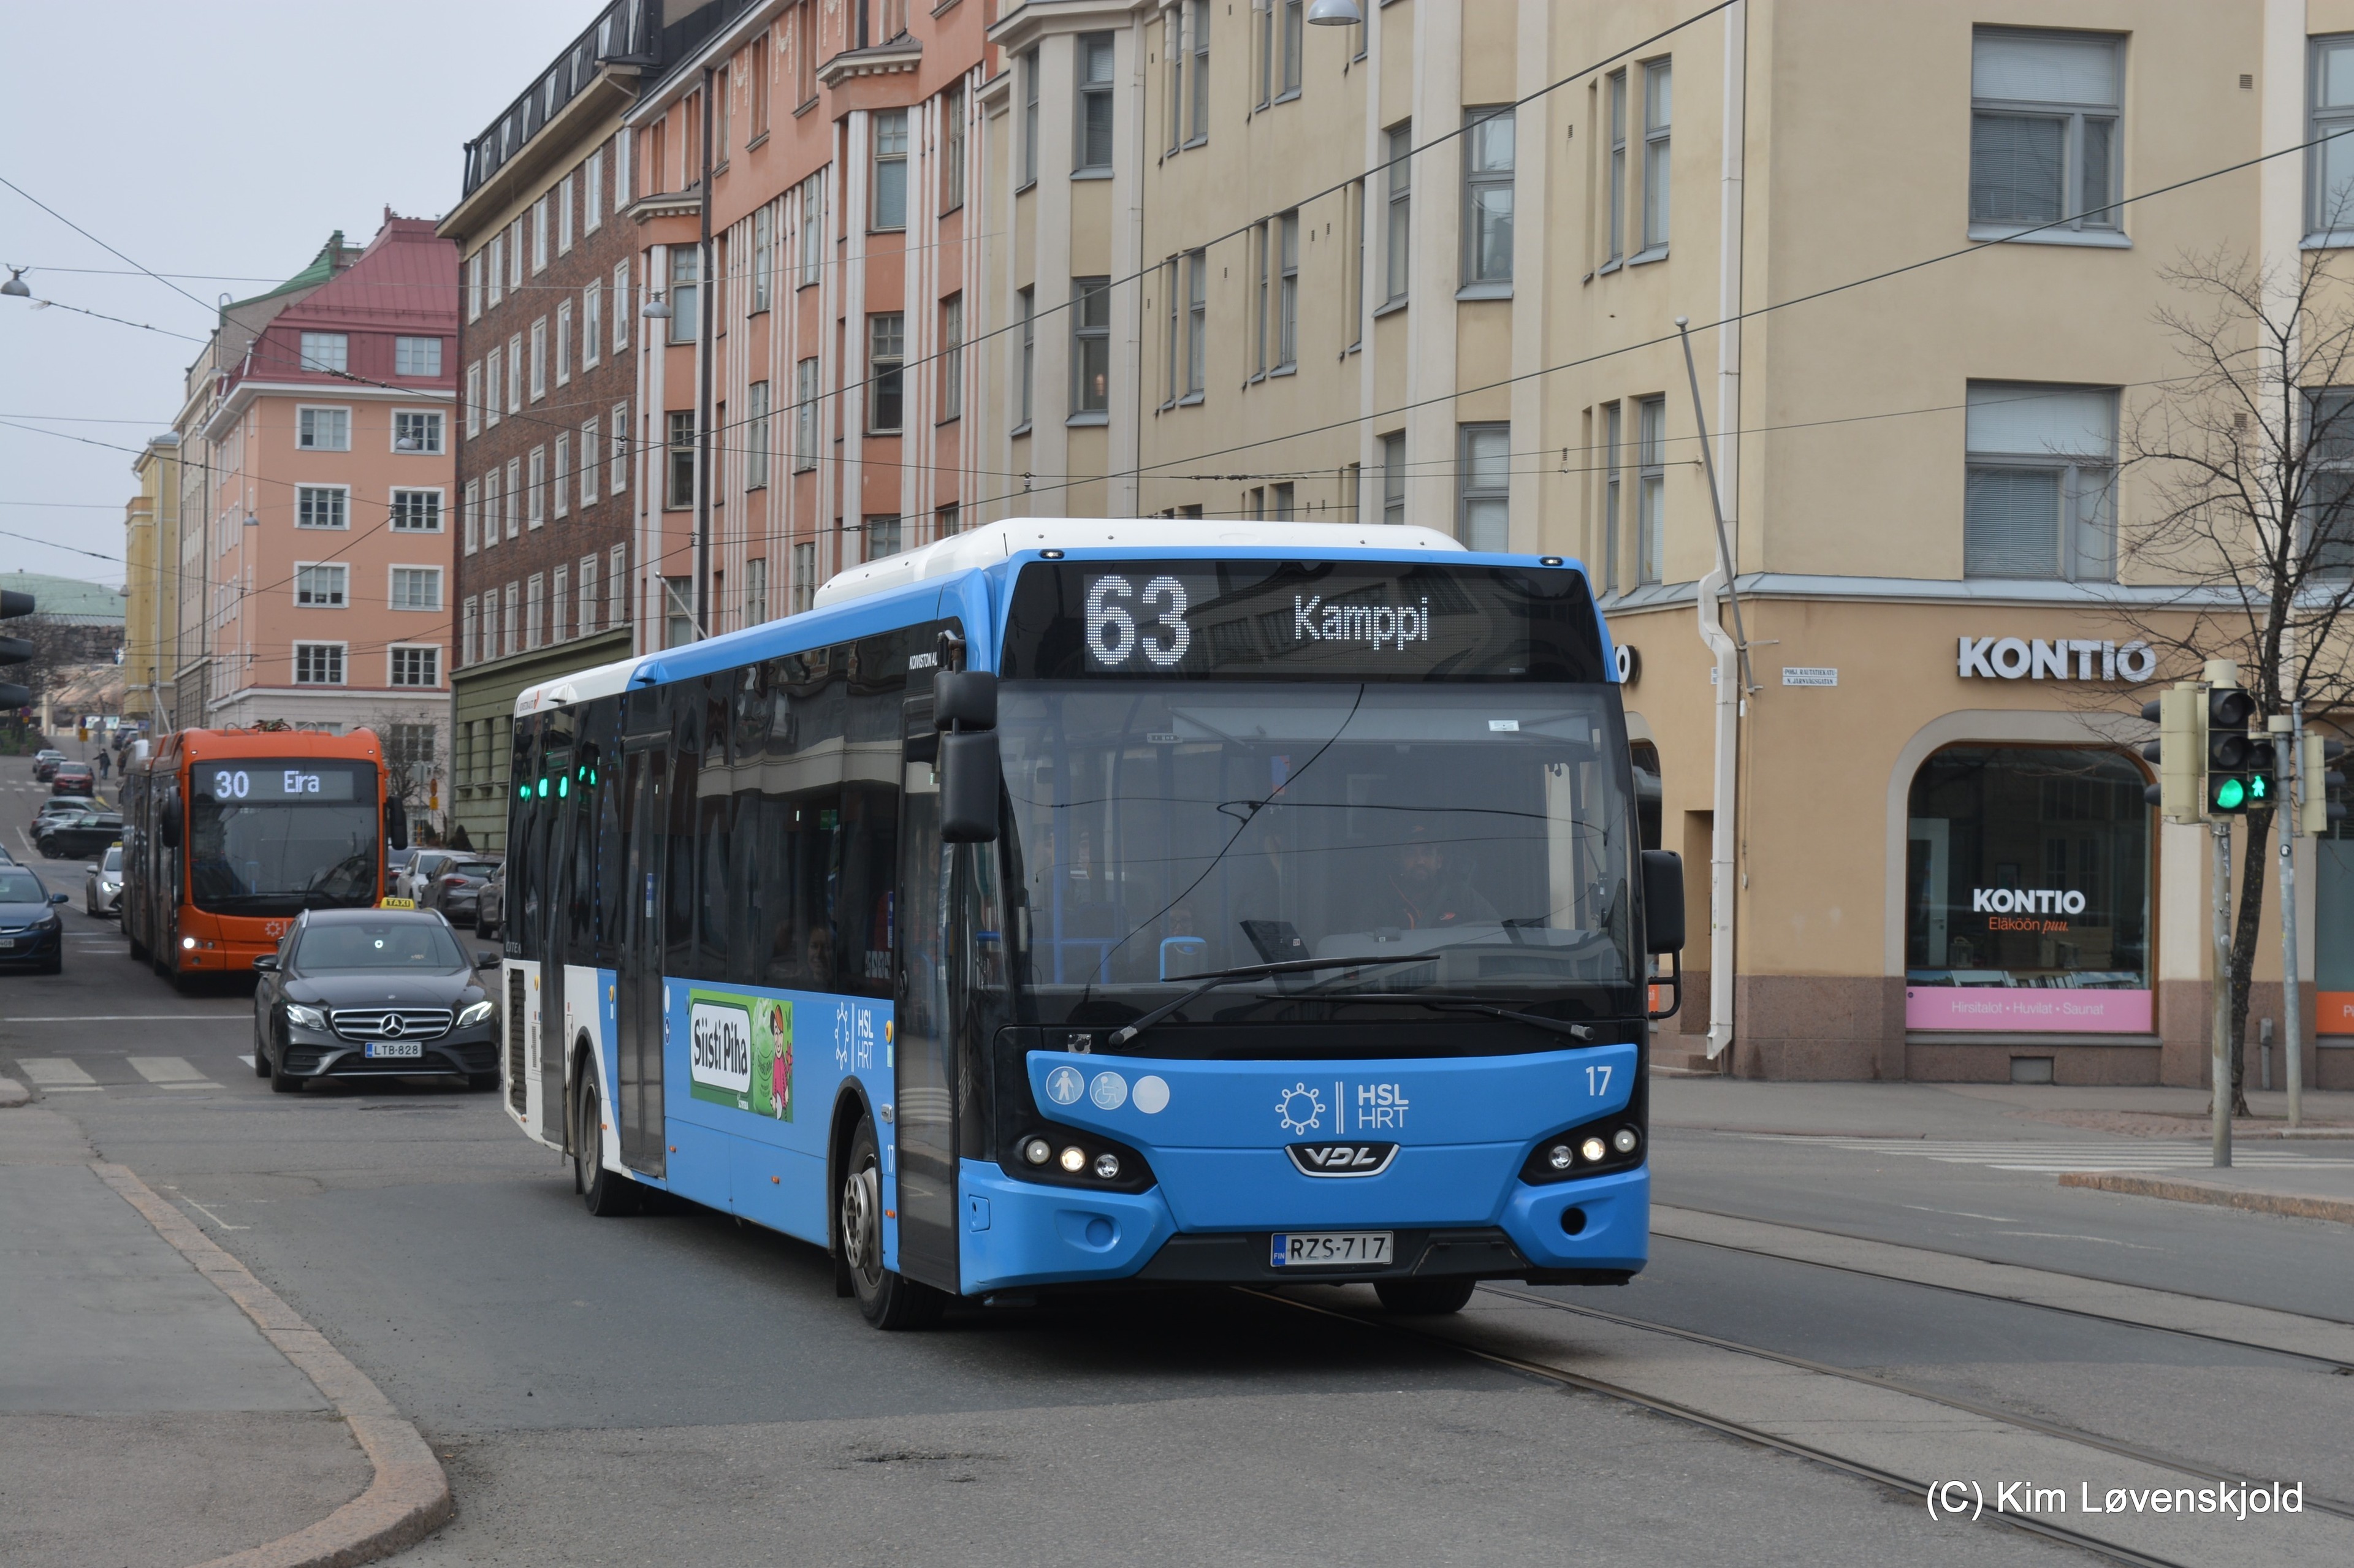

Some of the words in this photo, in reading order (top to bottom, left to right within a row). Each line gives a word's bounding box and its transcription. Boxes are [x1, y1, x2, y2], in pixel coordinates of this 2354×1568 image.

[1087, 575, 1190, 665] 63
[1295, 595, 1428, 651] Kamppi
[1959, 636, 2157, 683] KONTIO
[216, 771, 249, 797] 30
[284, 771, 319, 793] Eira
[1973, 888, 2085, 915] KONTIO
[1989, 916, 2040, 931] Eläköön
[1952, 1000, 2003, 1014] Hirsitalot
[2014, 1002, 2052, 1014] Huvilat
[2063, 1002, 2104, 1015] Saunat
[858, 1008, 874, 1038] HSL
[375, 1045, 418, 1055] LTB-828
[694, 1017, 721, 1070] Siisti
[723, 1021, 748, 1076] Piha
[858, 1040, 874, 1070] HRT
[1585, 1066, 1612, 1096] 17
[1358, 1084, 1409, 1106] HSL
[1358, 1106, 1409, 1129] HRT
[887, 1144, 894, 1173] 17
[1304, 1147, 1377, 1166] VDL
[1290, 1237, 1386, 1260] RZS-717
